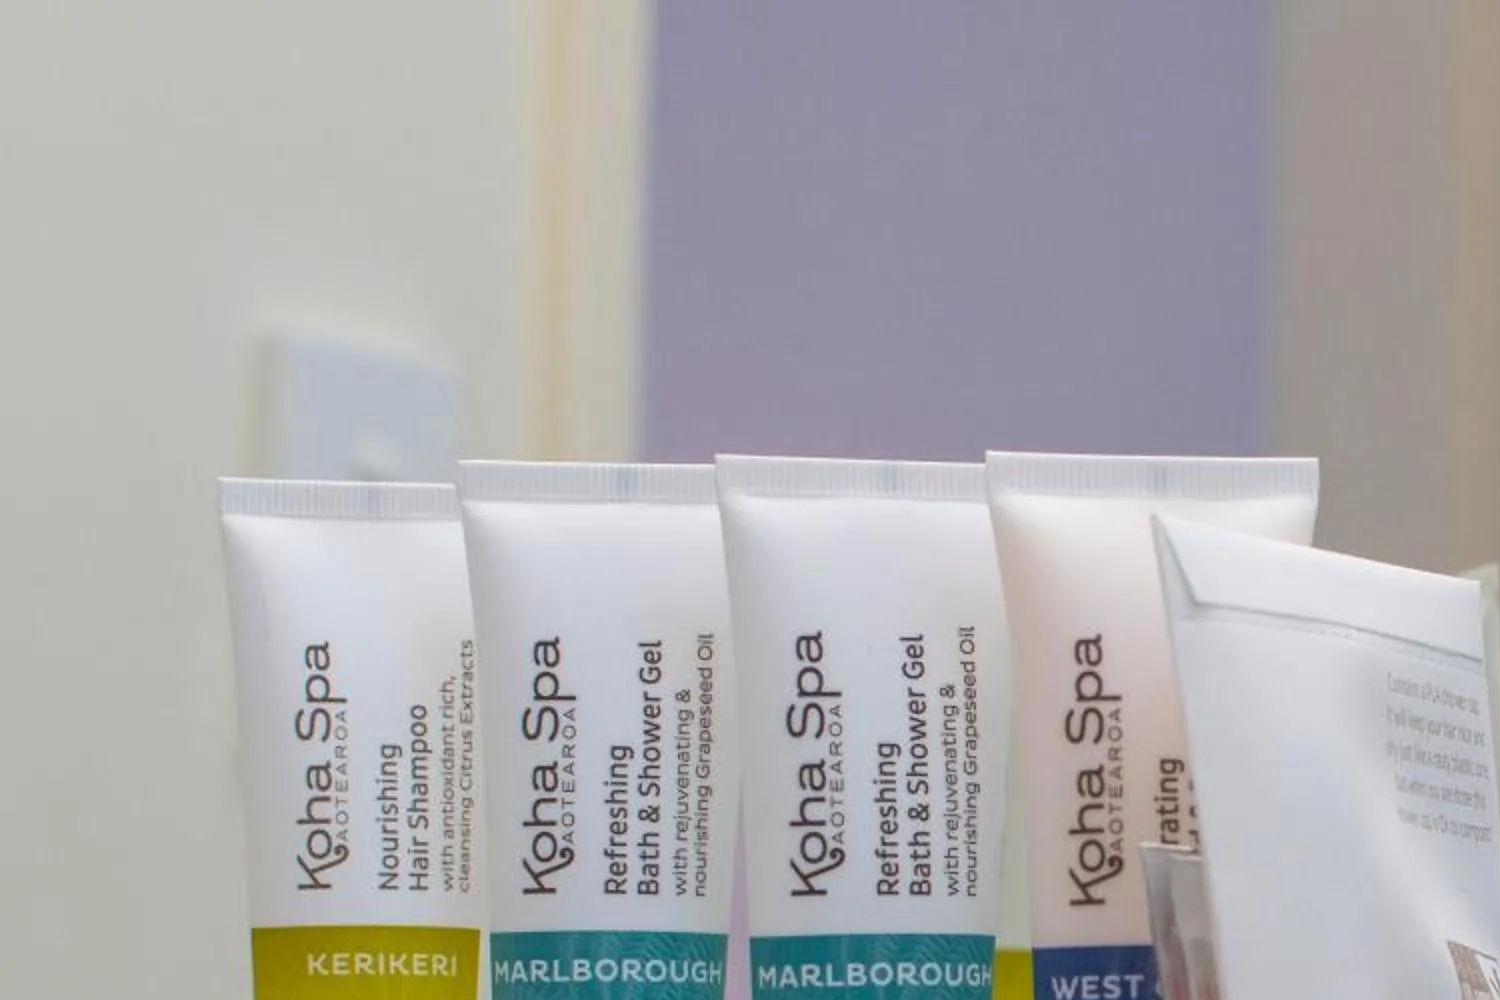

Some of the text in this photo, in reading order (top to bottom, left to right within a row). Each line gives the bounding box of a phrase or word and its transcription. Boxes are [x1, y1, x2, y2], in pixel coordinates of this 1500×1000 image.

[295, 641, 349, 891] Koha Spa
[334, 709, 349, 842] AOTEAROA
[375, 744, 402, 890] Nourishing
[405, 704, 432, 891] Hair Shampoo
[438, 676, 456, 891] with antioxidant rich,
[459, 639, 474, 893] cleansing Citrus Extracts
[521, 635, 577, 895] Koha Spa
[561, 707, 576, 845] AOTEAROA
[603, 745, 634, 895] Refreshing
[637, 640, 662, 896] Bath & Shower Gel
[672, 689, 694, 896] with rejuvenating &
[693, 633, 714, 898] nourishing Grapeseed Oil
[785, 630, 845, 897] Koha Spa
[828, 704, 845, 845] AOTEAROA
[873, 743, 901, 897] Refreshing
[898, 633, 932, 897] Bath & Shower Gel
[939, 684, 961, 897] with rejuvenating &
[958, 626, 981, 897] nourishing Grapeseed Oil
[1064, 633, 1124, 907] Koha Spa
[1107, 707, 1124, 852] AOTEAROA
[1154, 757, 1184, 845] rating
[307, 952, 457, 977] KERIKERI
[495, 958, 721, 985] MARLBOROUGH
[759, 962, 992, 988] MARLBOROUGH
[1051, 974, 1144, 1000] WEST
